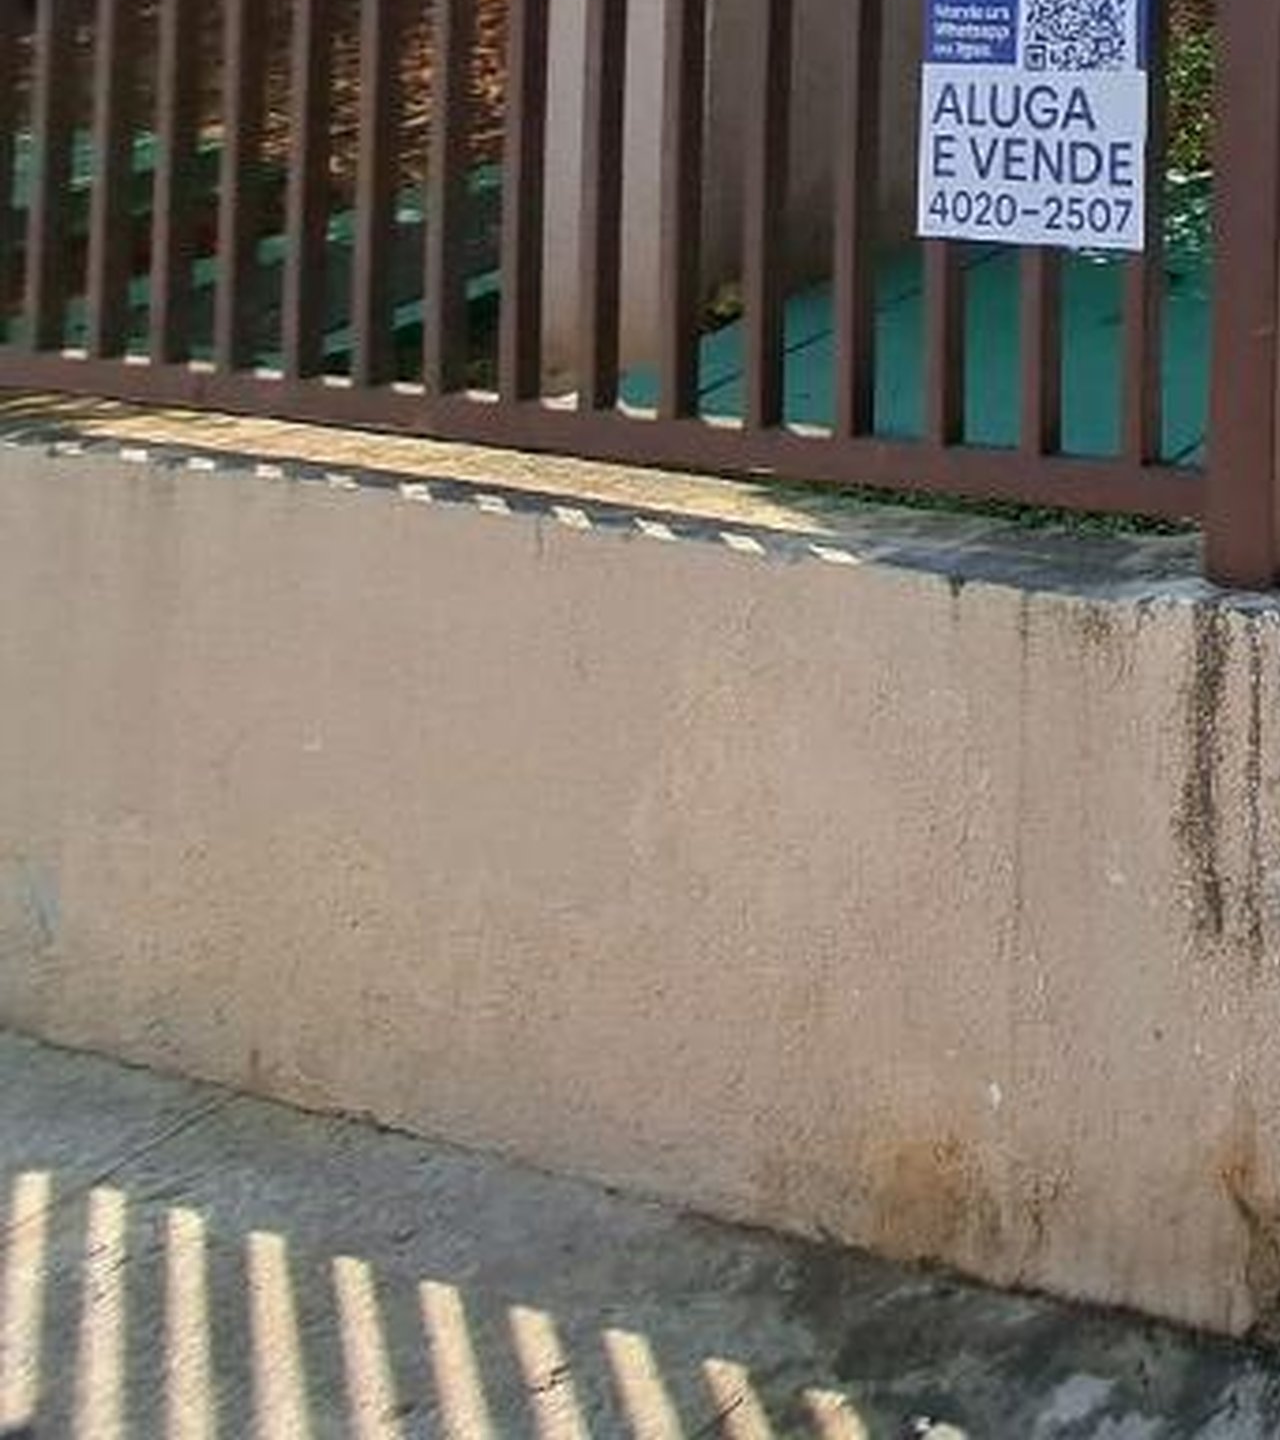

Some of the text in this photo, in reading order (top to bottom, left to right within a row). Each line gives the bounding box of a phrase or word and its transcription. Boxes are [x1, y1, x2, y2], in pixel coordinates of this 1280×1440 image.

[933, 83, 1096, 131] ALUGA
[934, 134, 1133, 186] E VENDE
[930, 190, 1133, 232] 4020-2507
